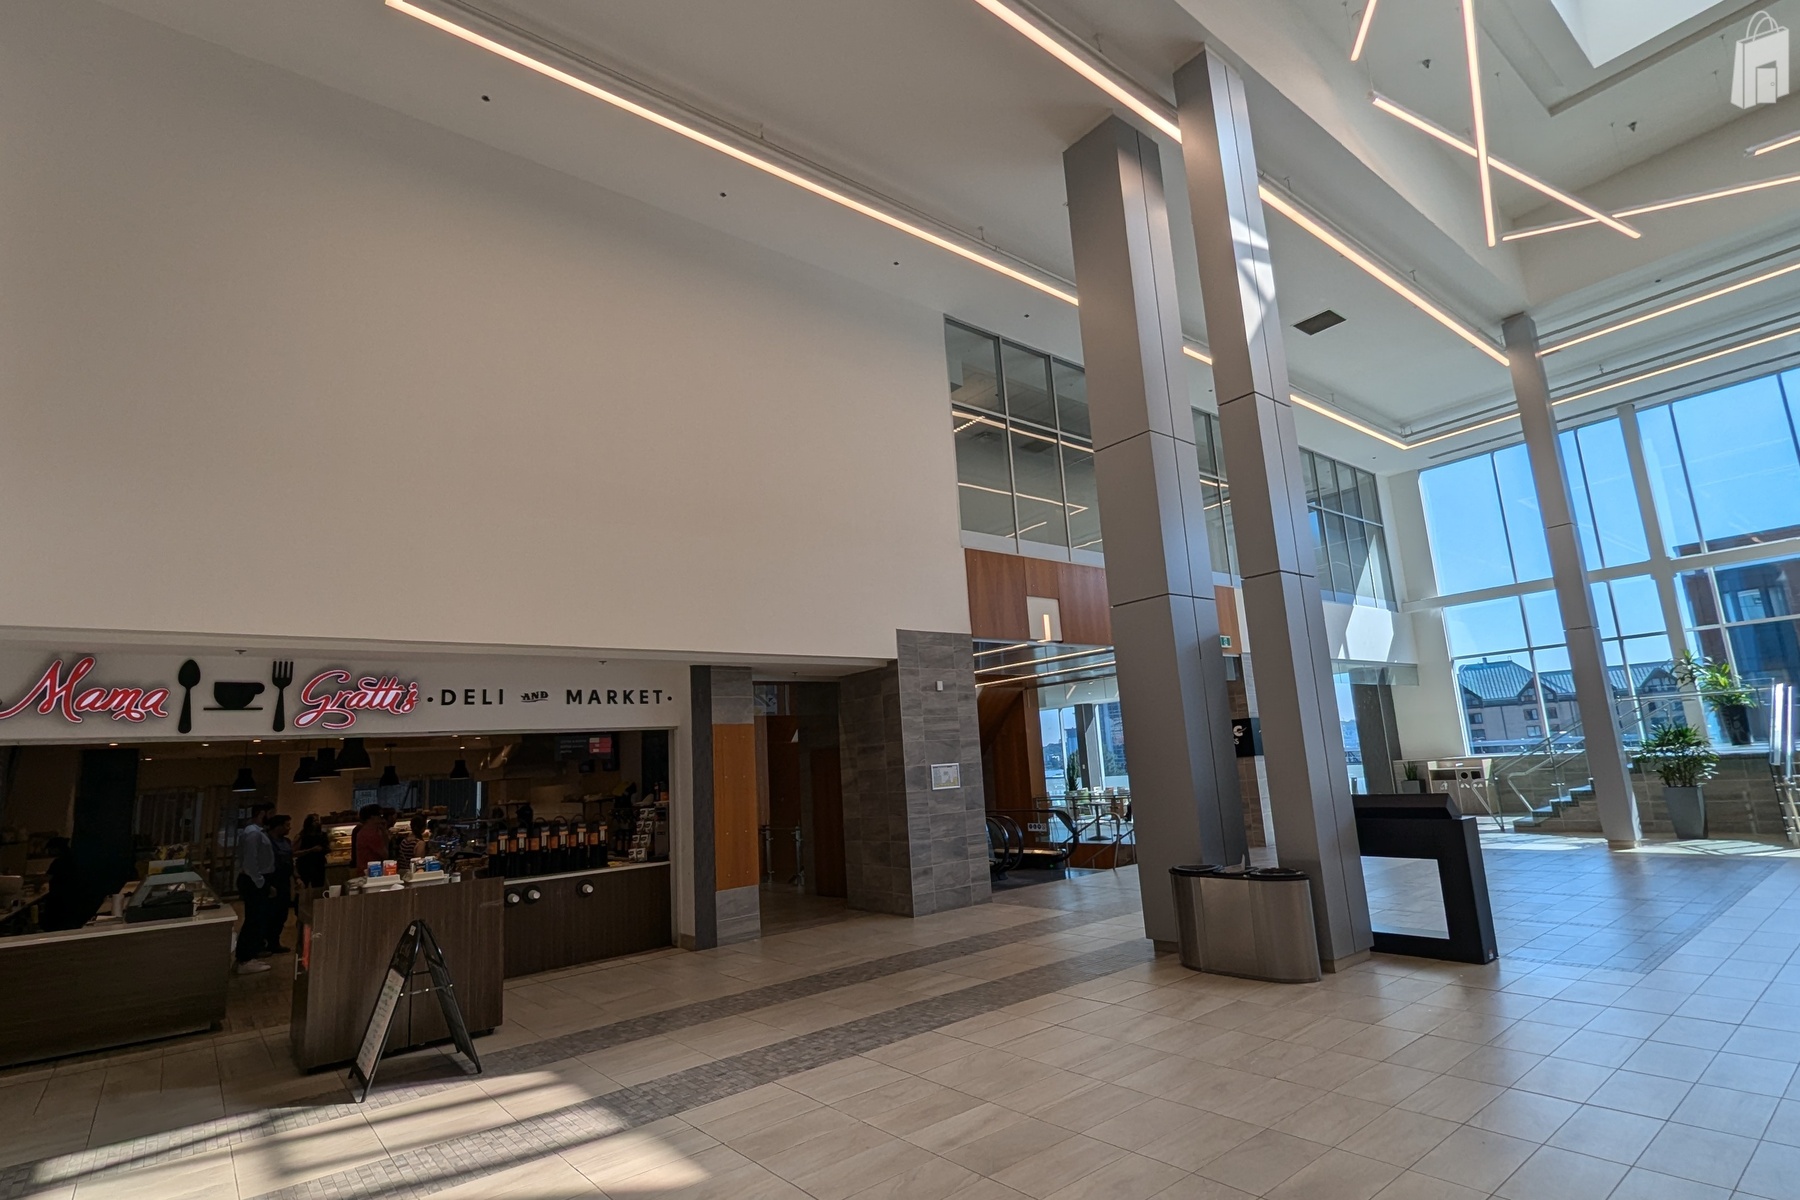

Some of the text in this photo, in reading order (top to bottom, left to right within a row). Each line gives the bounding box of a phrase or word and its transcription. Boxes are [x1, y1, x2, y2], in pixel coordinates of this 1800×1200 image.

[0, 657, 170, 723] Mama
[441, 689, 504, 705] DELI
[520, 691, 549, 701] AND
[566, 690, 663, 704] MARKET
